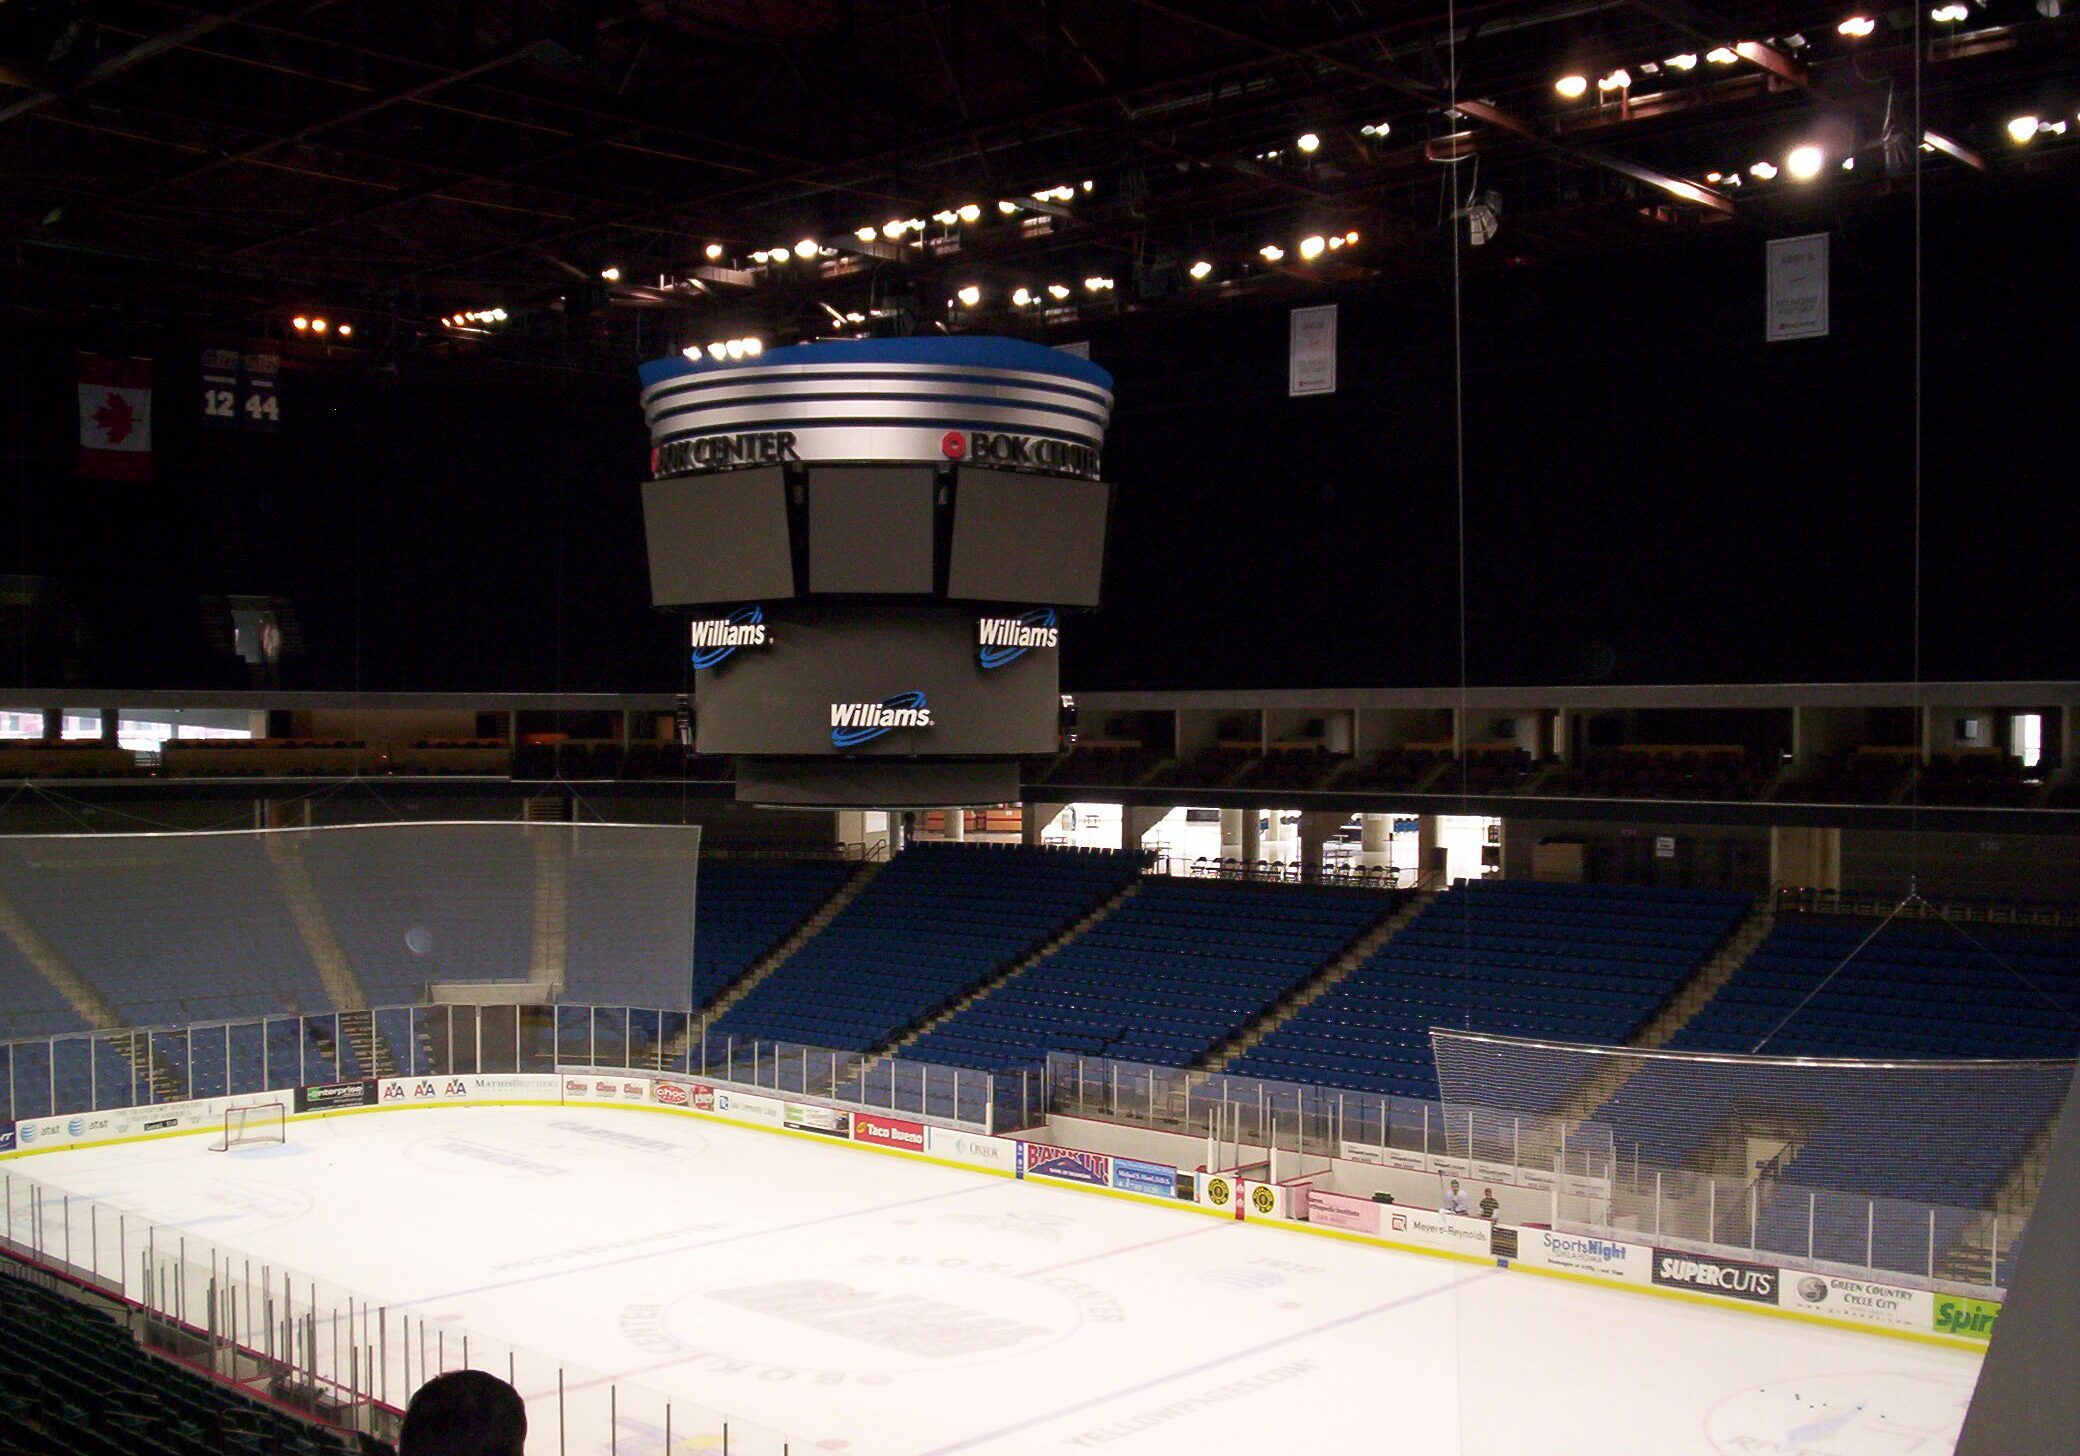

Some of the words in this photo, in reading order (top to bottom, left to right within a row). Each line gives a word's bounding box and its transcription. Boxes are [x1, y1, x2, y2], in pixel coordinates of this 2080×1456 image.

[205, 390, 235, 417] 12
[245, 394, 279, 421] 44
[971, 432, 1031, 462] BOK
[691, 620, 765, 647] Williams
[979, 619, 1058, 648] Williams
[831, 704, 931, 727] Williams
[867, 1123, 889, 1138] Taco
[891, 1128, 922, 1144] Bueno
[1027, 1144, 1081, 1172] BANK
[1083, 1154, 1109, 1187] IT!
[1544, 1232, 1627, 1261] SportsNight
[1660, 1257, 1771, 1295] SUPERCUTS
[1830, 1279, 1863, 1293] GREEN
[1866, 1284, 1913, 1302] COUNTRY
[1844, 1293, 1873, 1308] CYCLE
[1876, 1298, 1899, 1311] CITY
[1936, 1302, 1999, 1333] Spir
